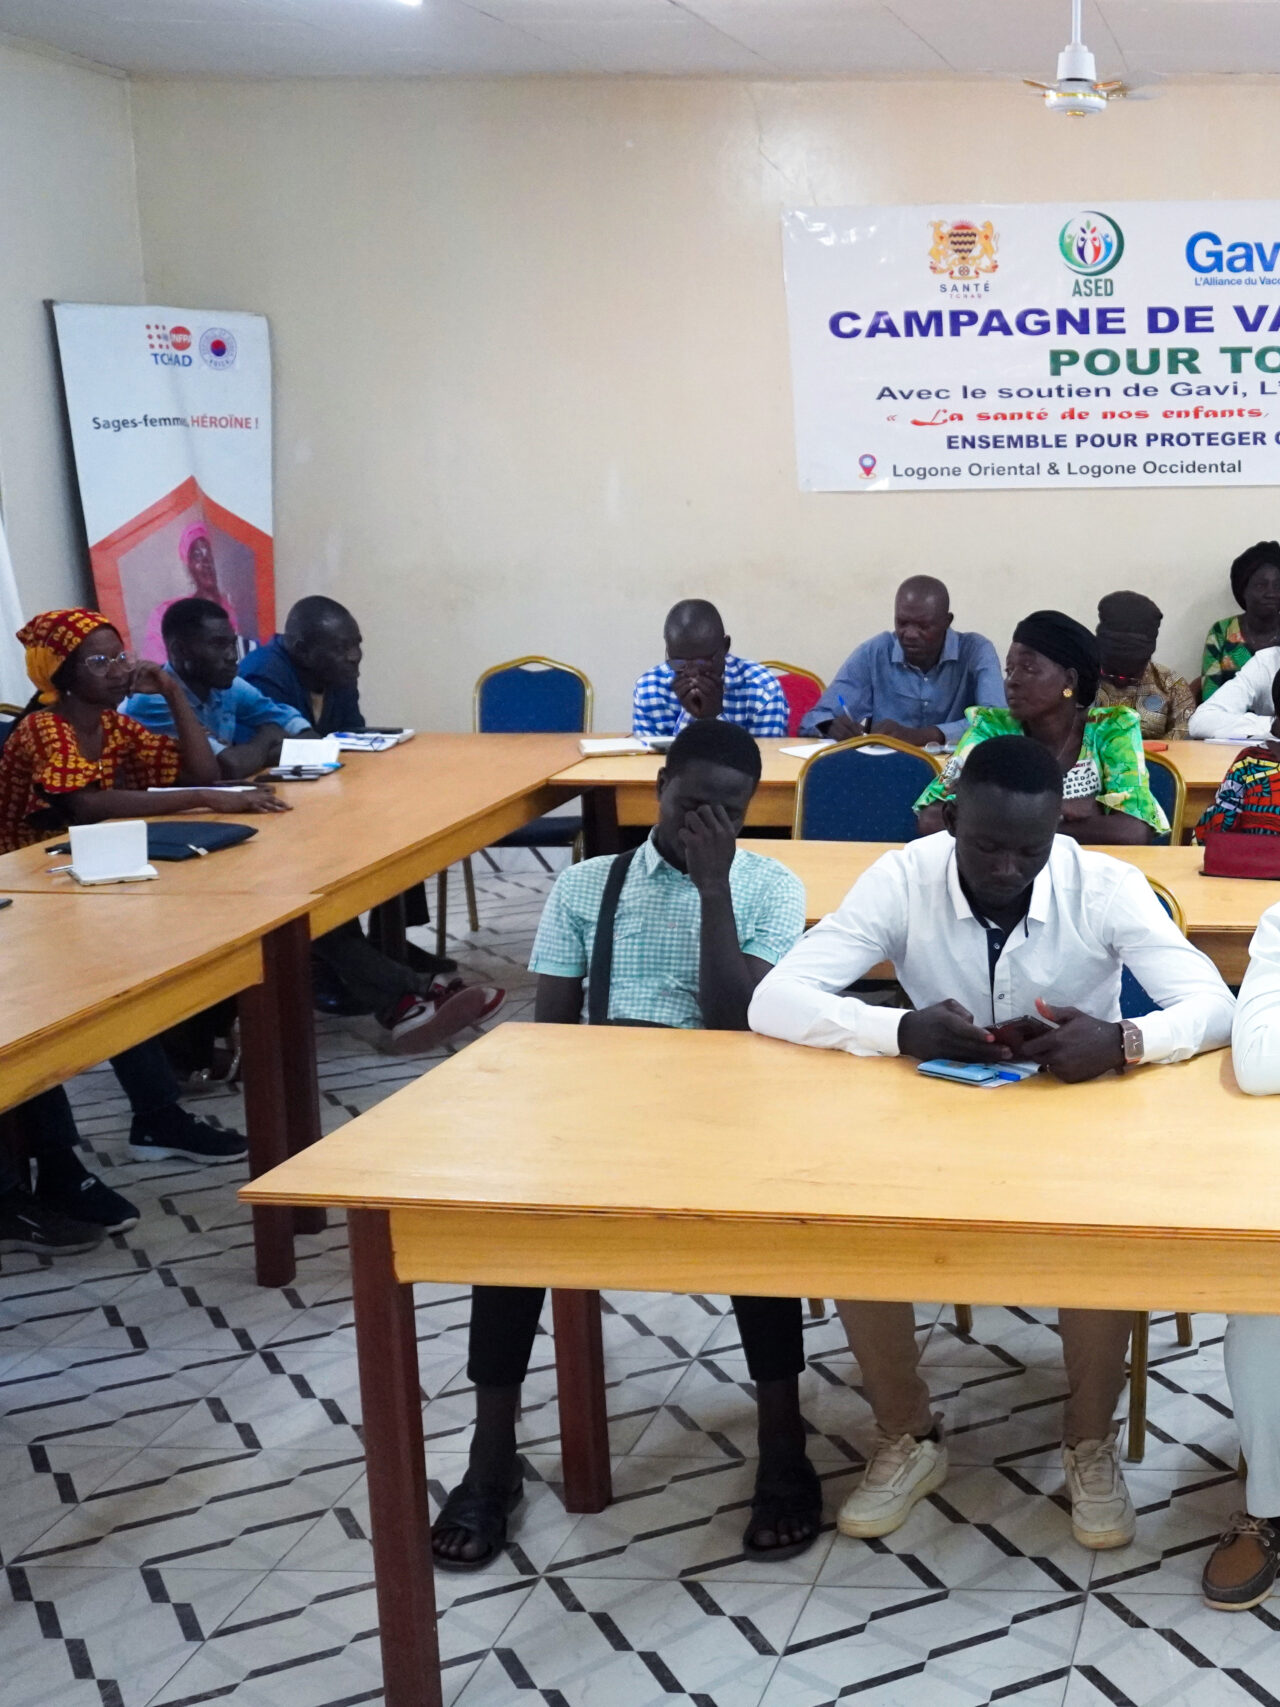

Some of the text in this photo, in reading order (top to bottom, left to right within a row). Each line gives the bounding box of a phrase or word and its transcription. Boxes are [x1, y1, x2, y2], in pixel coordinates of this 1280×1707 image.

[940, 280, 990, 293] SANTÉ
[1072, 279, 1113, 297] ASED
[1195, 277, 1242, 286] L'Alliance
[1244, 277, 1257, 285] du
[829, 307, 1126, 338] CAMPAGNE
[1147, 306, 1214, 333] DE
[151, 353, 192, 367] TCHAD
[1050, 348, 1201, 376] POUR
[876, 387, 950, 400] Avec
[963, 385, 986, 399] le
[998, 384, 1110, 398] soutien
[1123, 383, 1158, 397] de
[1170, 382, 1246, 397] Gavi,
[92, 414, 189, 432] Sages-femm,
[190, 413, 252, 429] HÉROÏNE
[911, 409, 963, 426] La
[977, 408, 1048, 421] santé
[1061, 408, 1089, 420] de
[1102, 411, 1149, 419] nos
[947, 434, 1067, 449] ENSEMBLE
[1076, 434, 1137, 448] POUR
[1146, 432, 1266, 447] PROTEGER
[893, 460, 1241, 480] Logone Oriental & Logone Occidental
